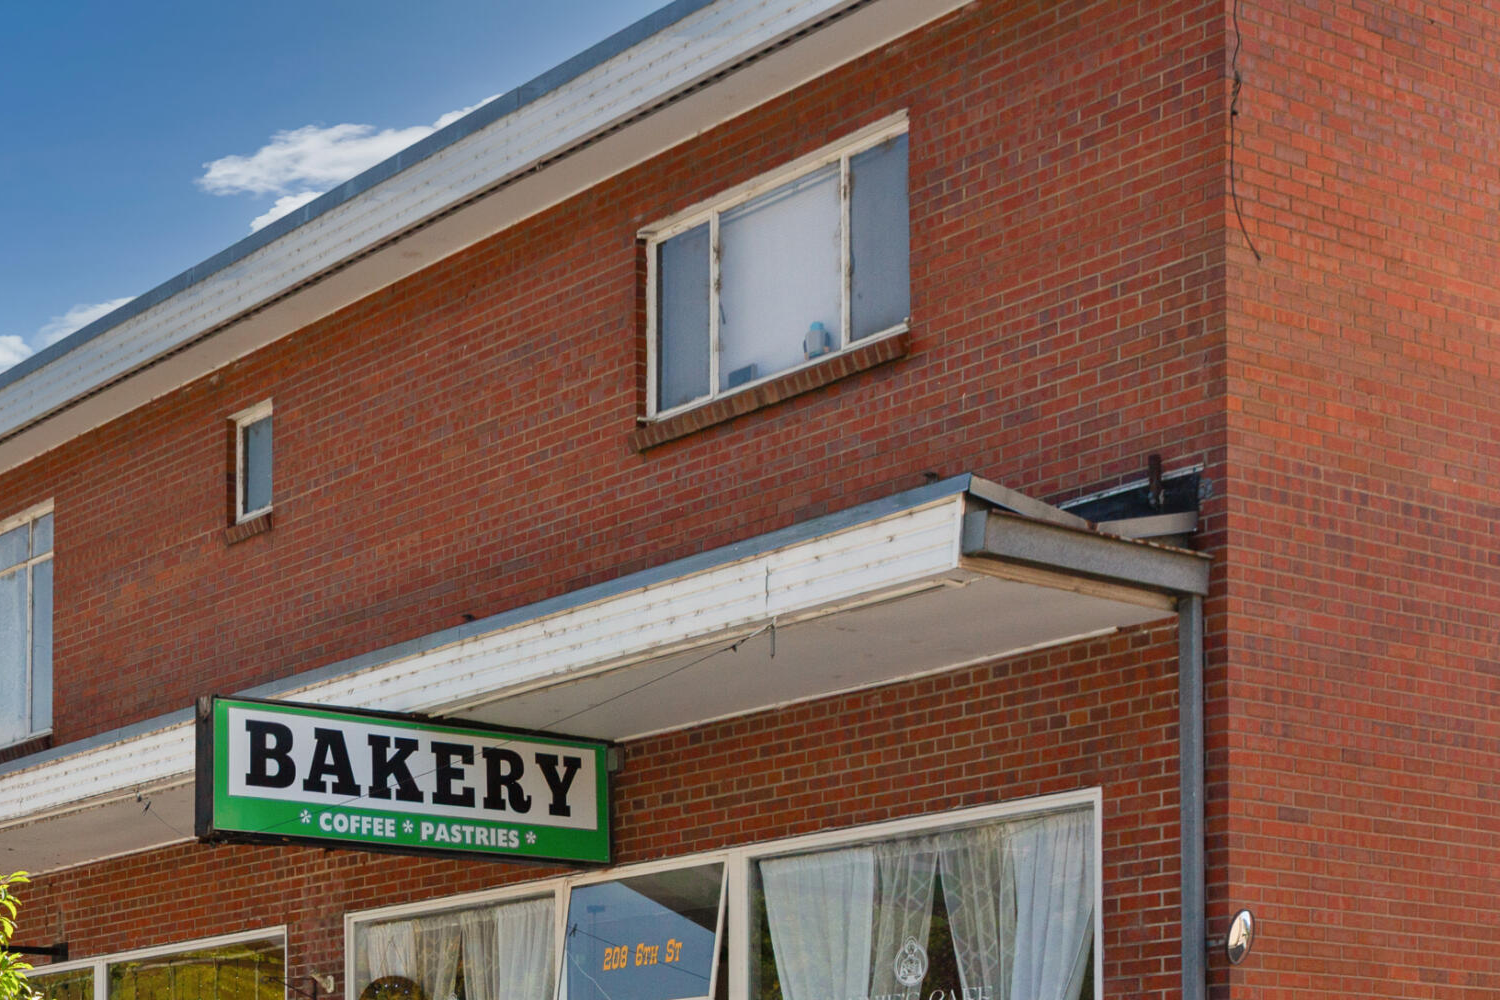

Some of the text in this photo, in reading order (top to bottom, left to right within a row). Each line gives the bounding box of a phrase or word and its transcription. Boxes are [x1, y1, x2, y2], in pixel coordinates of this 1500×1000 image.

[245, 719, 582, 817] BAKERY
[319, 813, 520, 848] COFFEE PASTRIES
[603, 947, 628, 971] 208
[635, 942, 659, 966] 6TH
